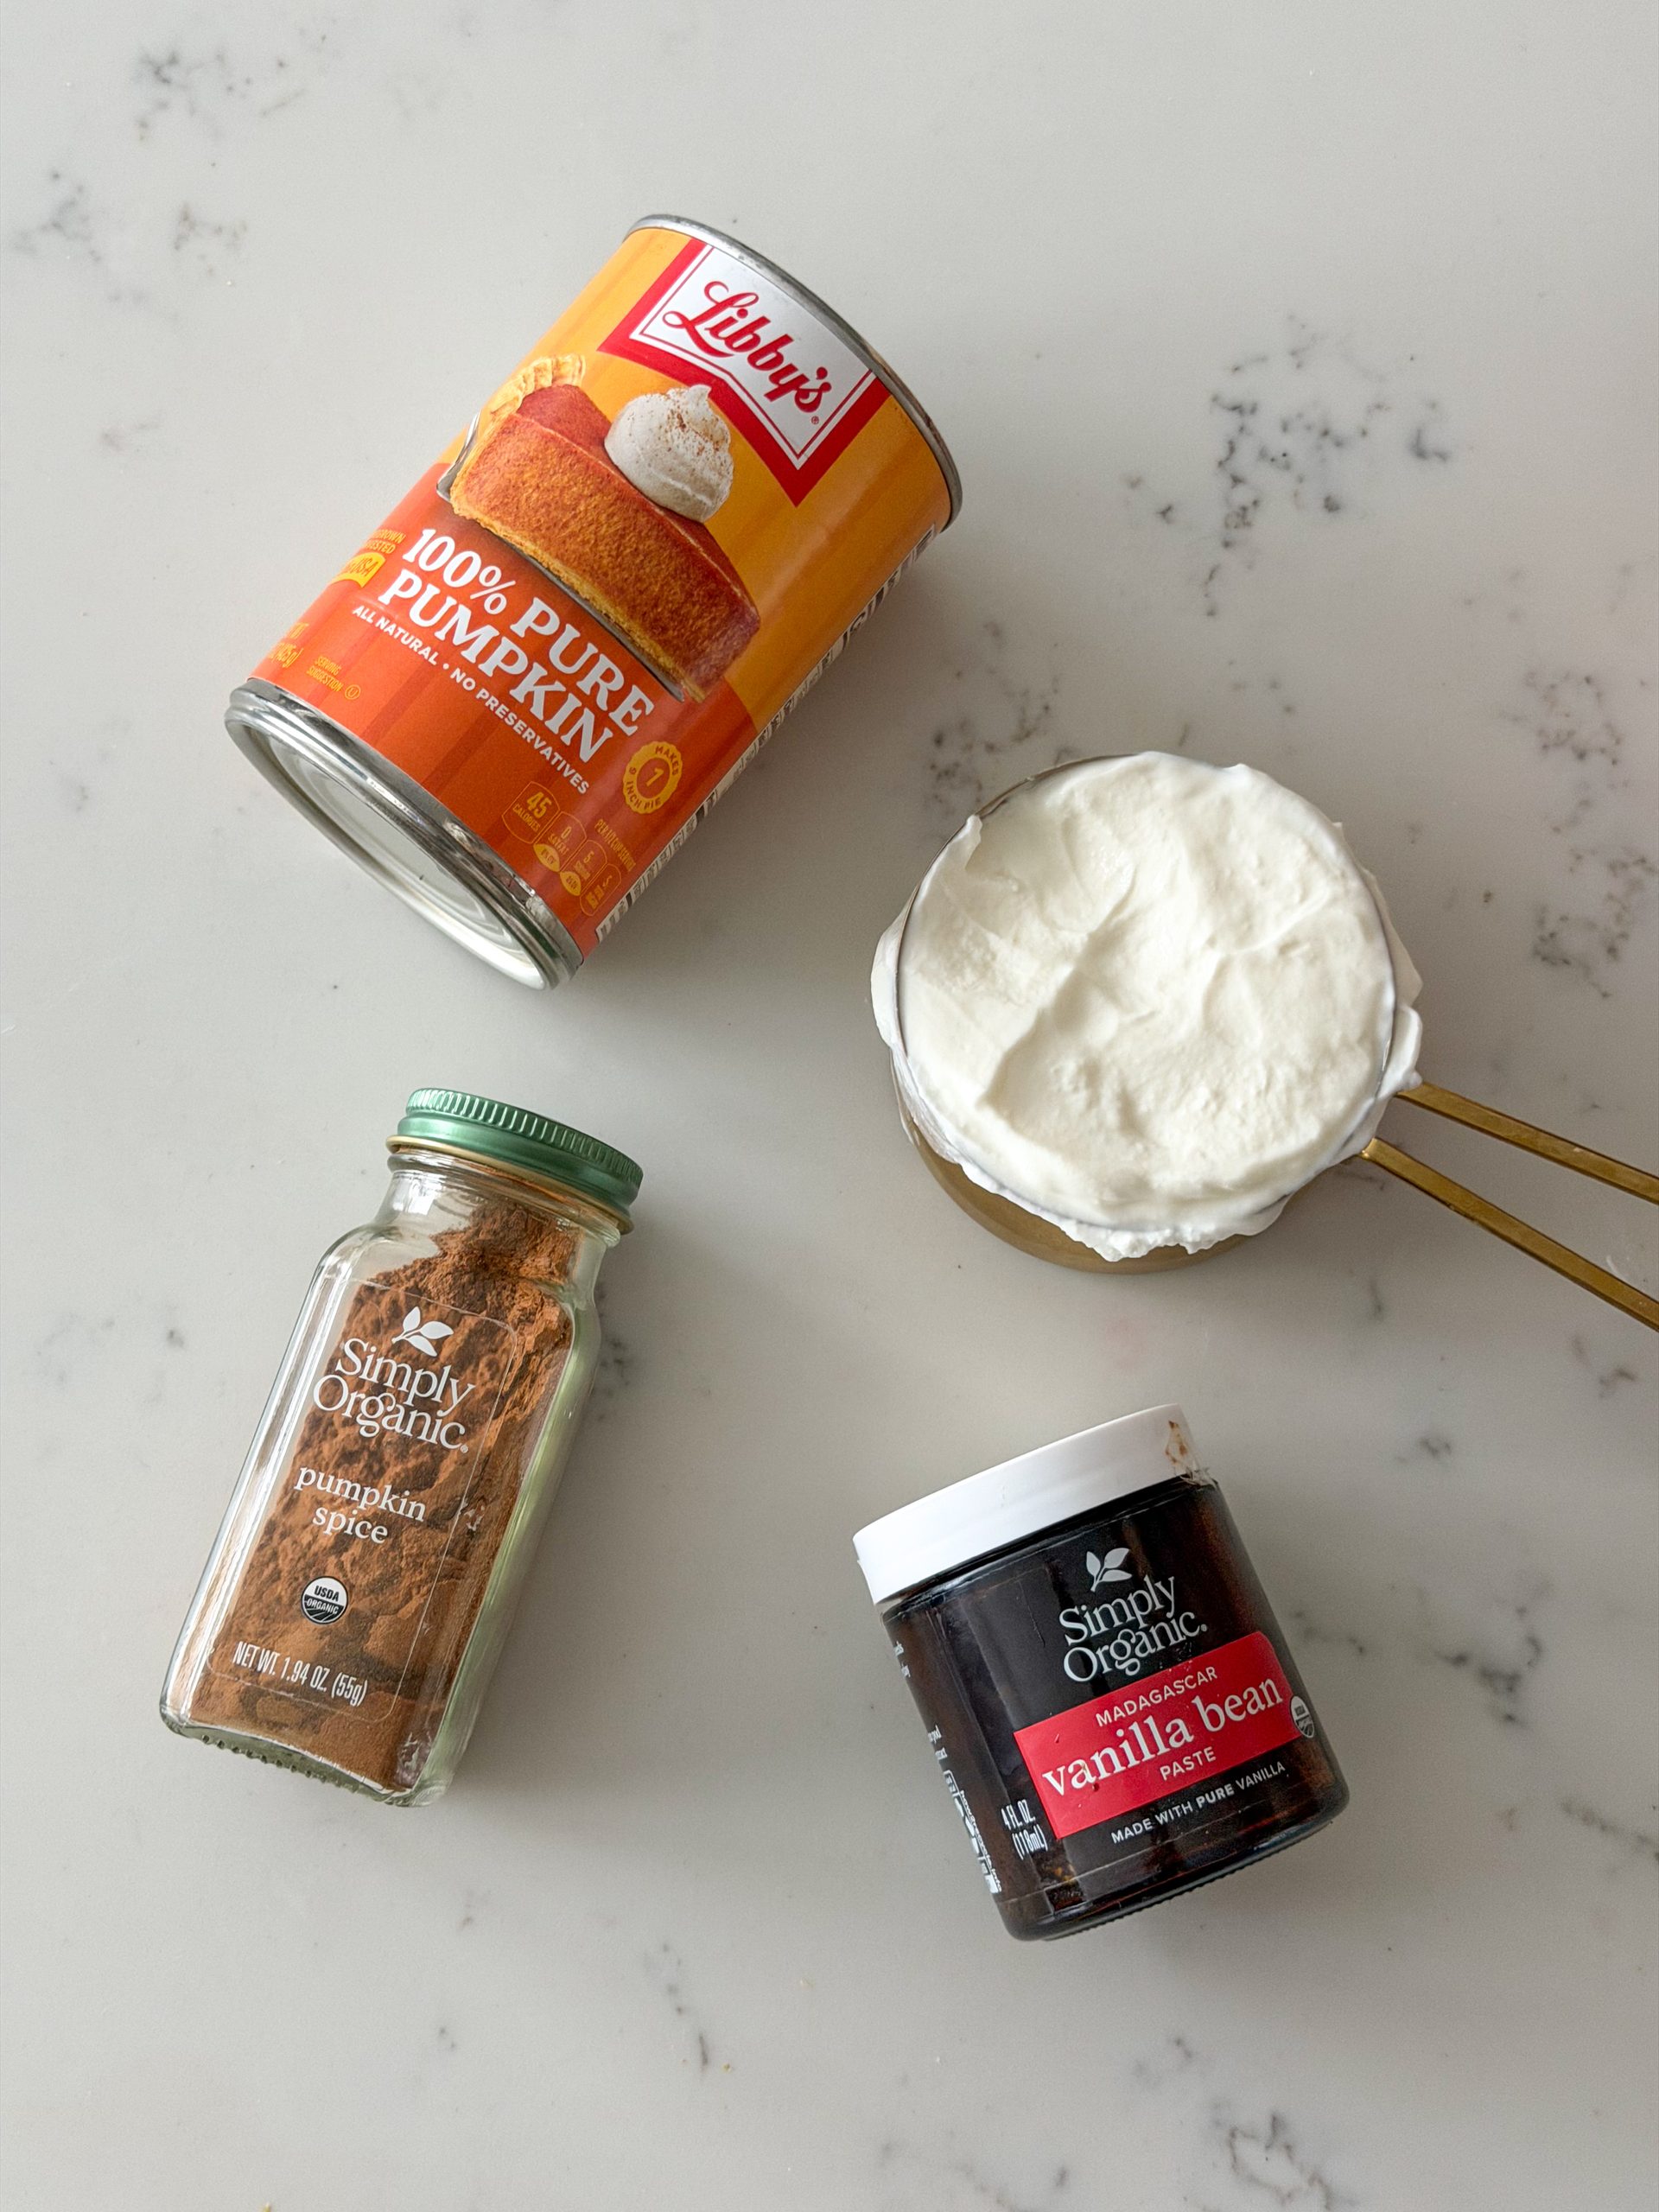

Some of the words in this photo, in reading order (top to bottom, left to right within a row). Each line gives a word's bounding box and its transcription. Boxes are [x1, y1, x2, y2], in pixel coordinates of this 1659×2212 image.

[662, 281, 831, 412] Libby's
[402, 528, 516, 615] 100%
[510, 597, 654, 736] PURE
[378, 569, 613, 763] PUMPKIN
[352, 606, 374, 624] ALL
[376, 617, 438, 665] NATURAL
[450, 668, 476, 692] NO
[475, 689, 590, 794] PRESERVATIVES
[646, 767, 664, 787] 1
[655, 746, 679, 776] MAKES
[512, 804, 541, 832] CALORIES
[526, 791, 552, 819] 45
[626, 780, 641, 810] INCH
[644, 798, 662, 810] PIE
[334, 1338, 475, 1417] Simply
[314, 1374, 466, 1450] Organic
[294, 1466, 426, 1522] pumpkin
[312, 1506, 388, 1544] spice
[306, 1598, 339, 1615] ORGANIC
[314, 1585, 340, 1602] USDA
[1059, 1576, 1175, 1647] Simply
[232, 1641, 260, 1669] NET
[257, 1648, 280, 1675] WT.
[280, 1656, 310, 1685] 1.94
[310, 1665, 330, 1692] OZ.
[331, 1672, 368, 1707] (55g)
[1095, 1666, 1218, 1727] MADAGASCAR
[1042, 1715, 1195, 1796] vanilla
[1192, 1676, 1283, 1732] bean
[1160, 1746, 1217, 1782] PASTE
[1001, 1808, 1011, 1830] 4
[1111, 1818, 1153, 1843] MADE
[1155, 1801, 1193, 1826] WITH
[1195, 1783, 1236, 1808] PURE
[1235, 1760, 1286, 1790] VANILLA
